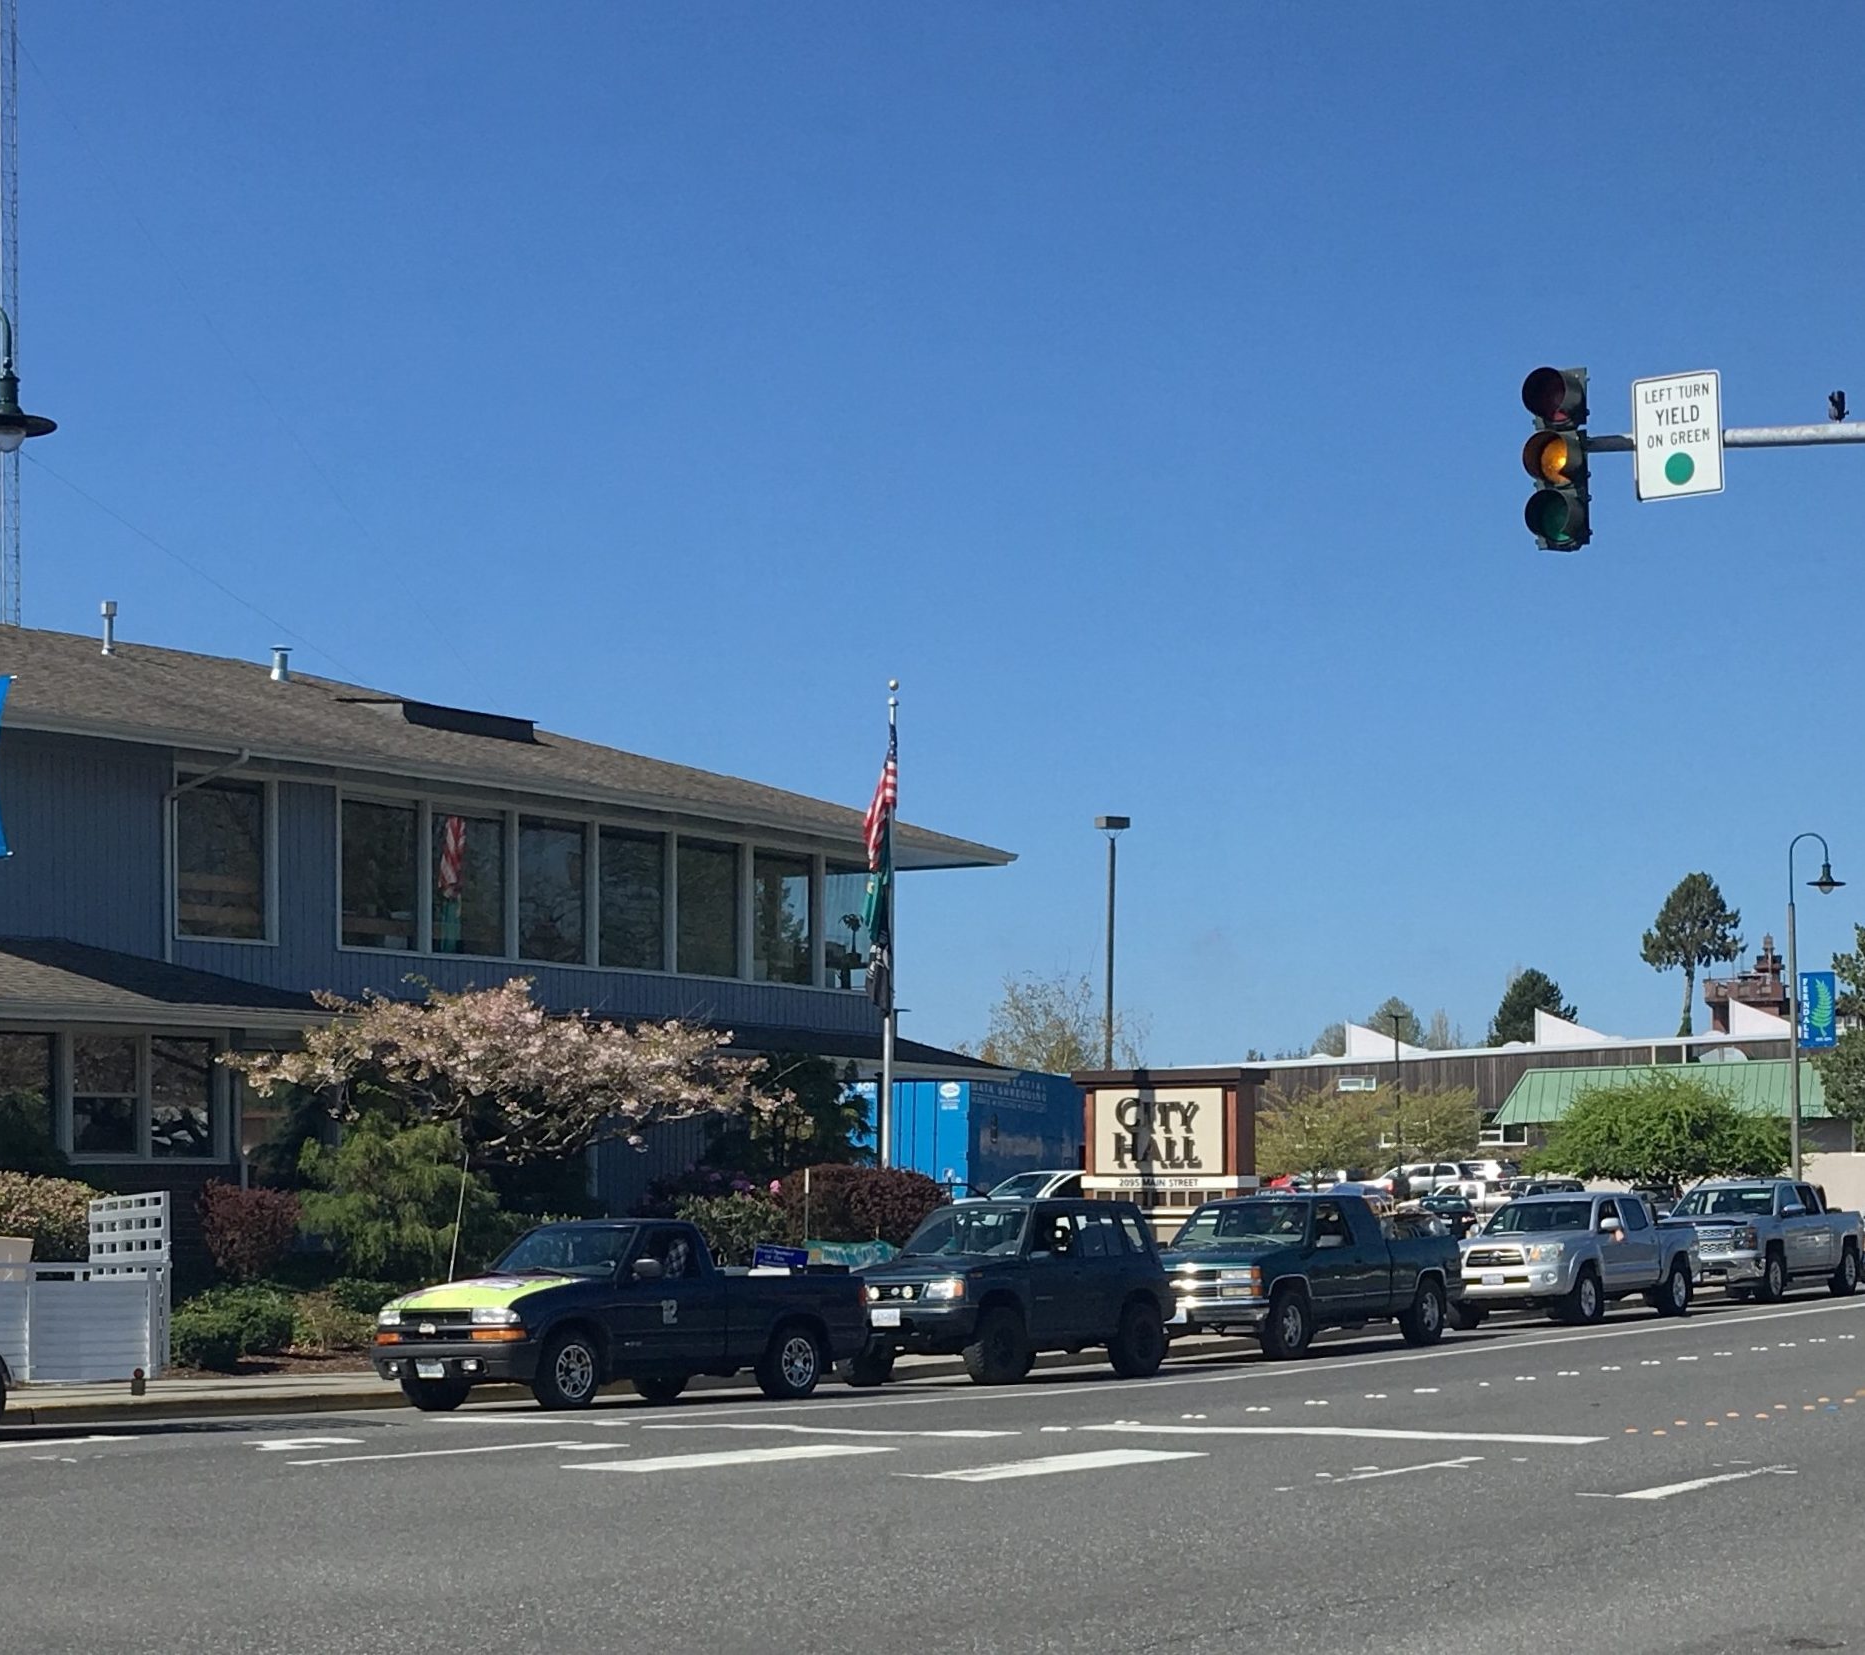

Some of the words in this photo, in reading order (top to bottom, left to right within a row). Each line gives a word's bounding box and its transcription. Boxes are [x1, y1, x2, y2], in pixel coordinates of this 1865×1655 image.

[1644, 387, 1673, 404] LEFT
[1678, 382, 1710, 399] TURN
[1655, 404, 1700, 427] YIELD
[1647, 433, 1664, 449] ON
[1670, 427, 1711, 446] GREEN
[1119, 1178, 1140, 1188] 2095
[1142, 1178, 1166, 1188] MAIN
[1168, 1178, 1199, 1188] STREET
